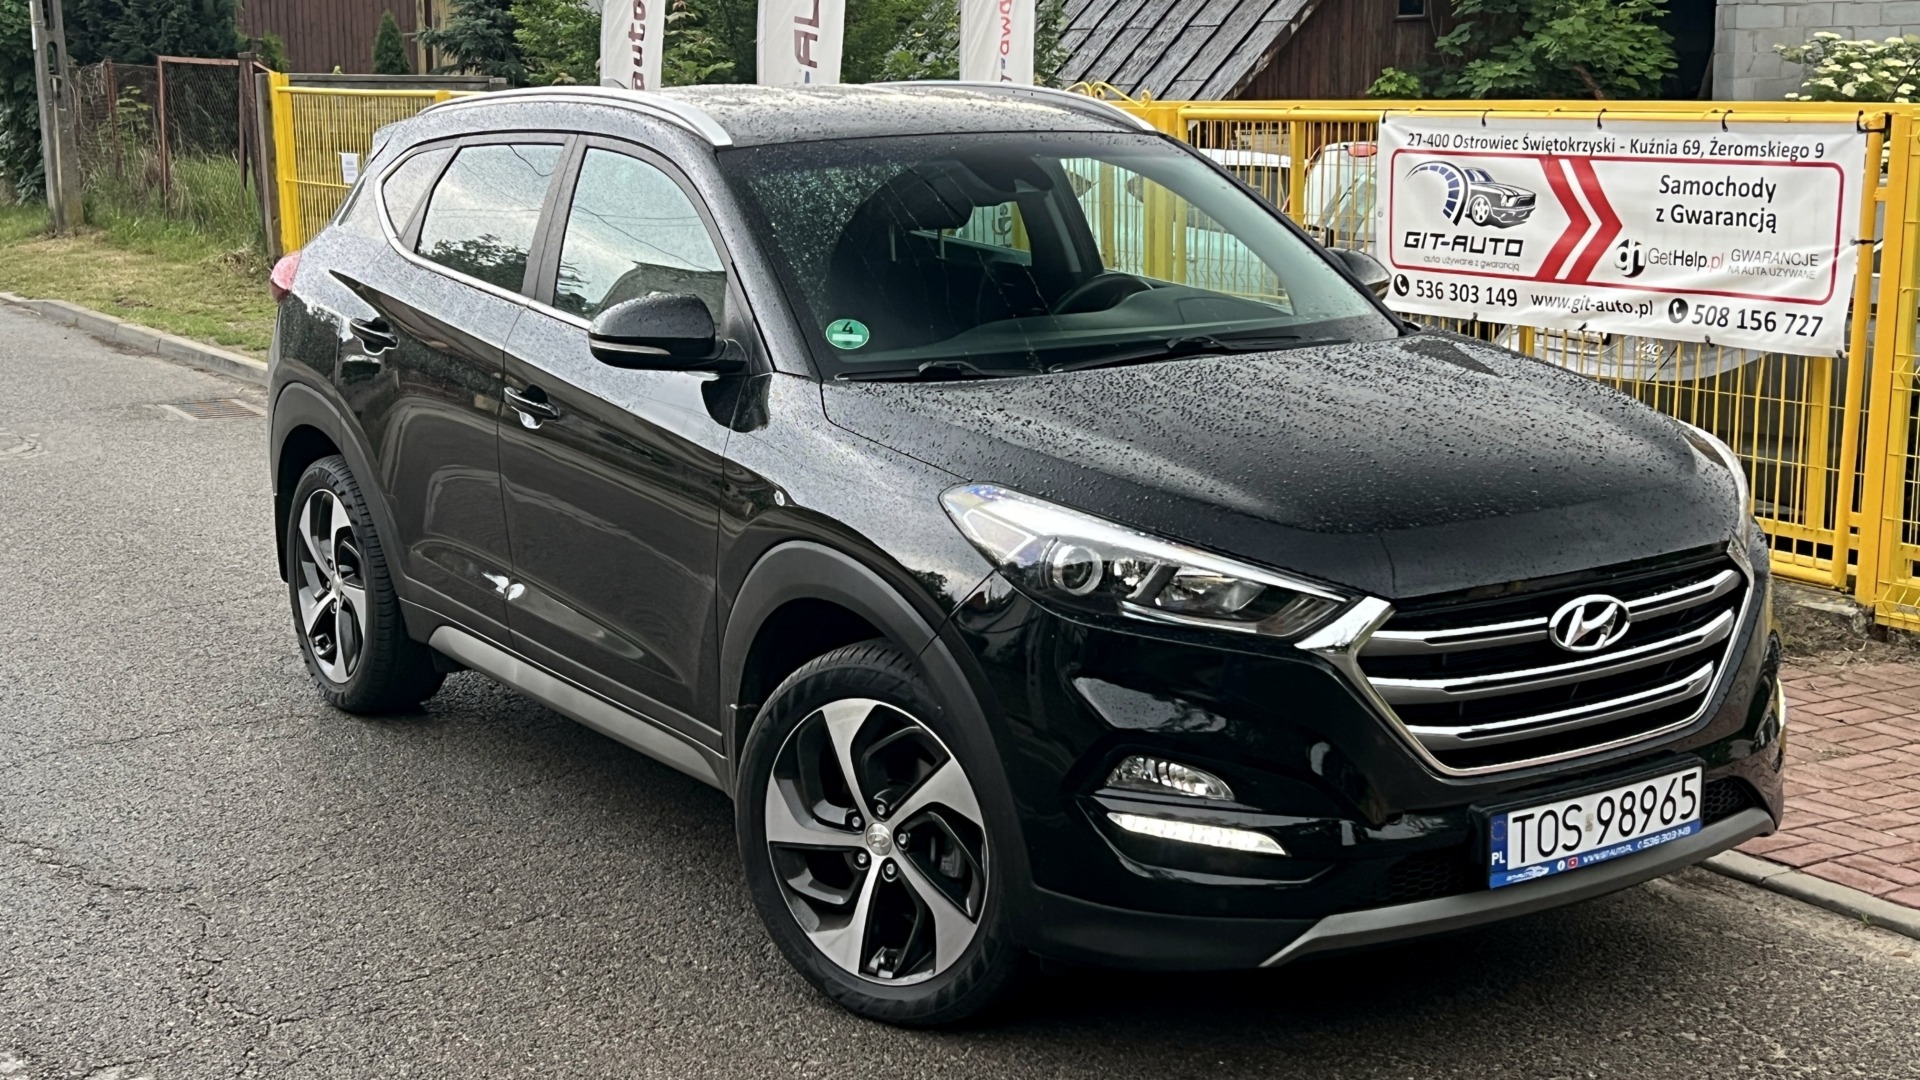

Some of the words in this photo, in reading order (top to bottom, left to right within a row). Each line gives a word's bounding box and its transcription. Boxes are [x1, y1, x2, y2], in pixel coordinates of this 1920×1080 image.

[1407, 133, 1449, 148] 27-400
[1453, 134, 1519, 151] Ostrowiec
[1522, 132, 1615, 156] Świętokrzyski
[1630, 138, 1678, 155] Kuźnia
[1682, 139, 1705, 158] 69,
[1709, 137, 1809, 162] Żeromskiego
[1814, 142, 1825, 159] 9
[1659, 174, 1777, 203] Samochody
[1656, 207, 1664, 222] z
[1670, 204, 1777, 234] Gwarancją
[1404, 231, 1524, 257] GIT-AUTO
[1480, 260, 1520, 272] gwarancją
[1648, 247, 1724, 272] GetHelp.pl
[1731, 248, 1819, 267] GWARANCJE
[1727, 265, 1740, 275] NA
[1741, 266, 1768, 276] AUTA
[1769, 266, 1816, 280] UŻYWANE
[1416, 279, 1444, 300] 536
[1449, 283, 1479, 303] 303
[1485, 286, 1518, 307] 149
[1530, 293, 1653, 318] www.git-auto.pl
[842, 321, 853, 335] 4
[1692, 304, 1730, 327] 508
[1736, 308, 1777, 332] 156
[1785, 313, 1824, 337] 727
[1512, 803, 1583, 864] TOS
[1596, 771, 1697, 845] 98965
[1491, 851, 1506, 866] PL
